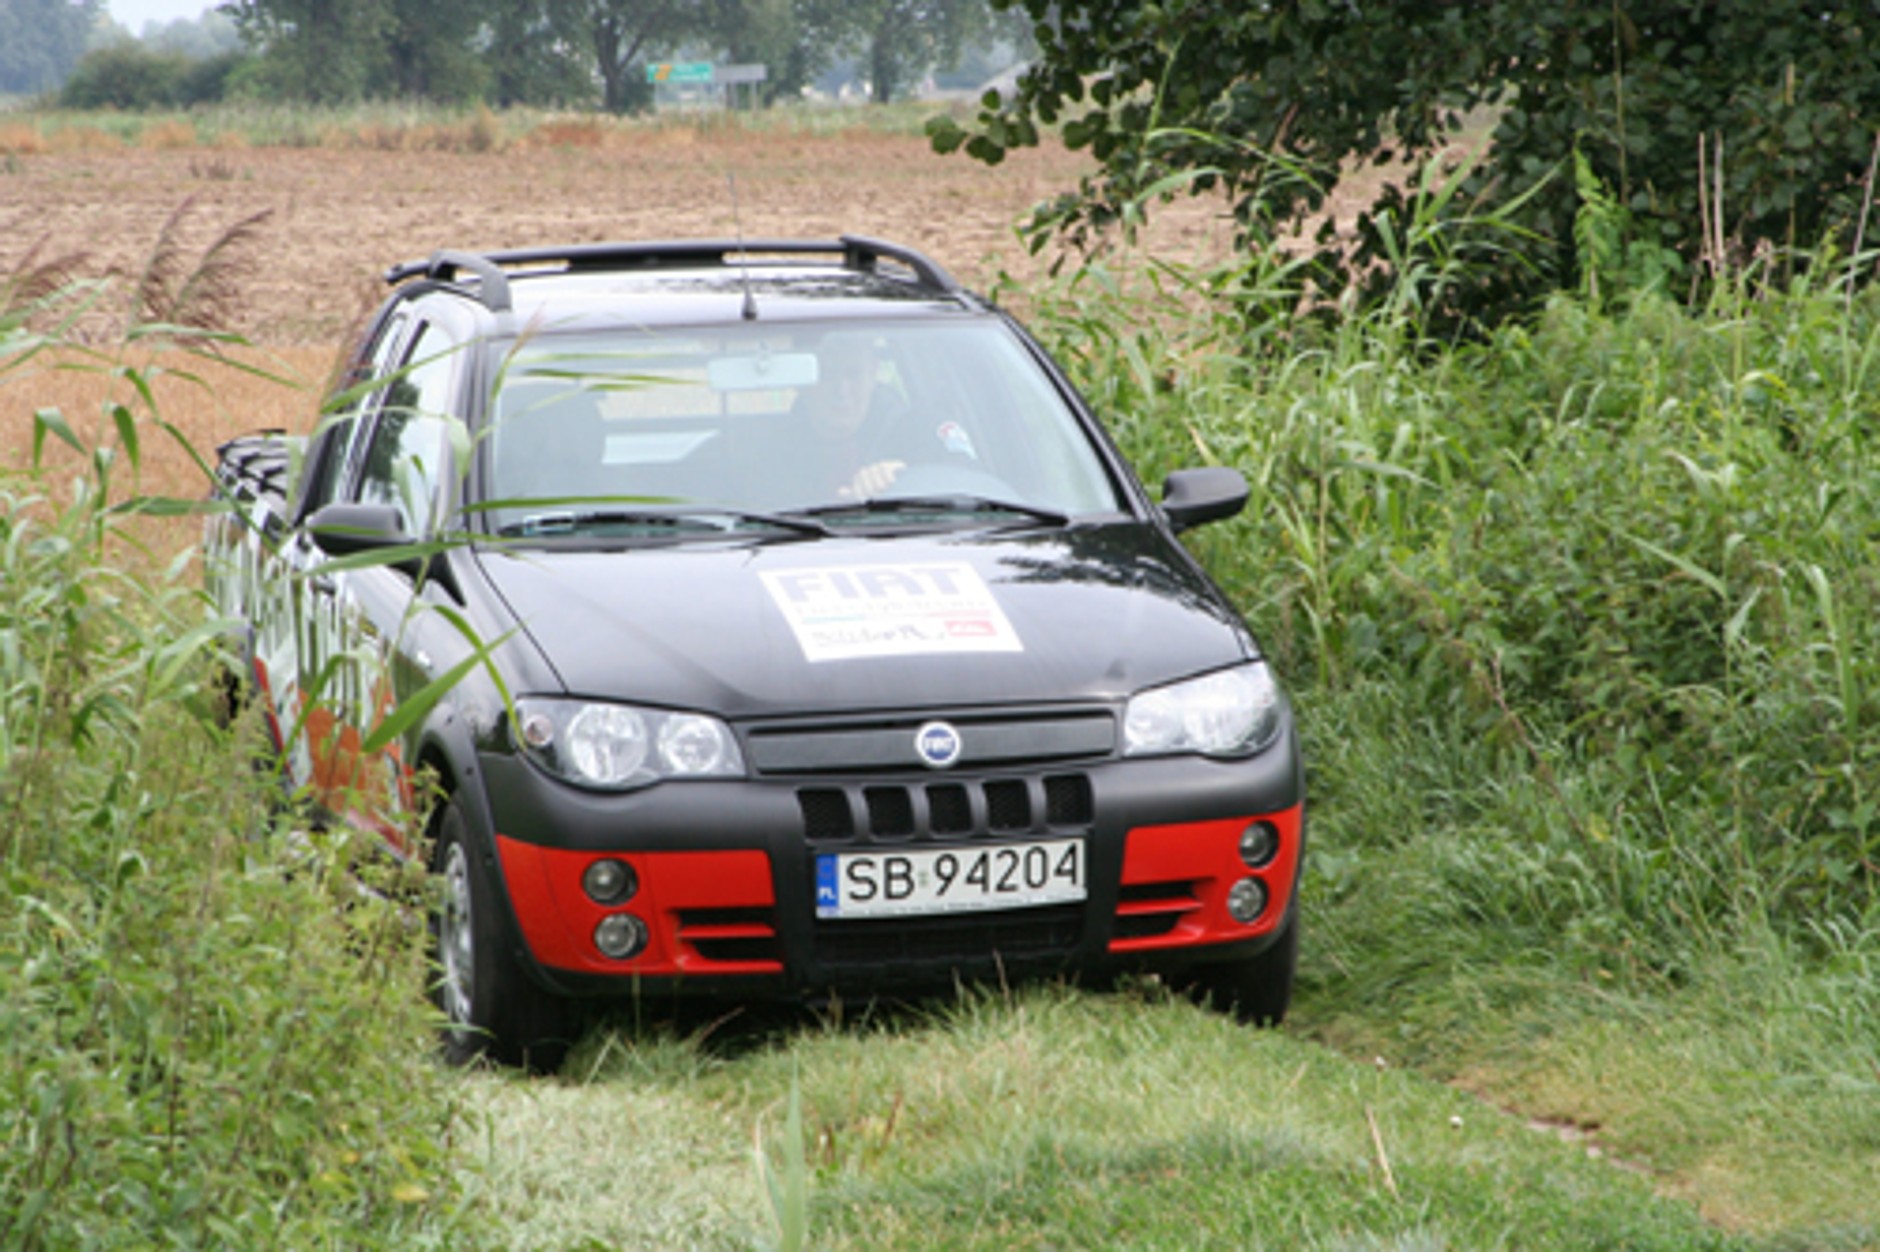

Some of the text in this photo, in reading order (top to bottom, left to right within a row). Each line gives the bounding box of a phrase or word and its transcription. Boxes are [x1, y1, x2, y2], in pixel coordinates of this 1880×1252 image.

[776, 567, 960, 603] FIAT
[846, 842, 1079, 901] SB 94204
[818, 888, 837, 899] PL
